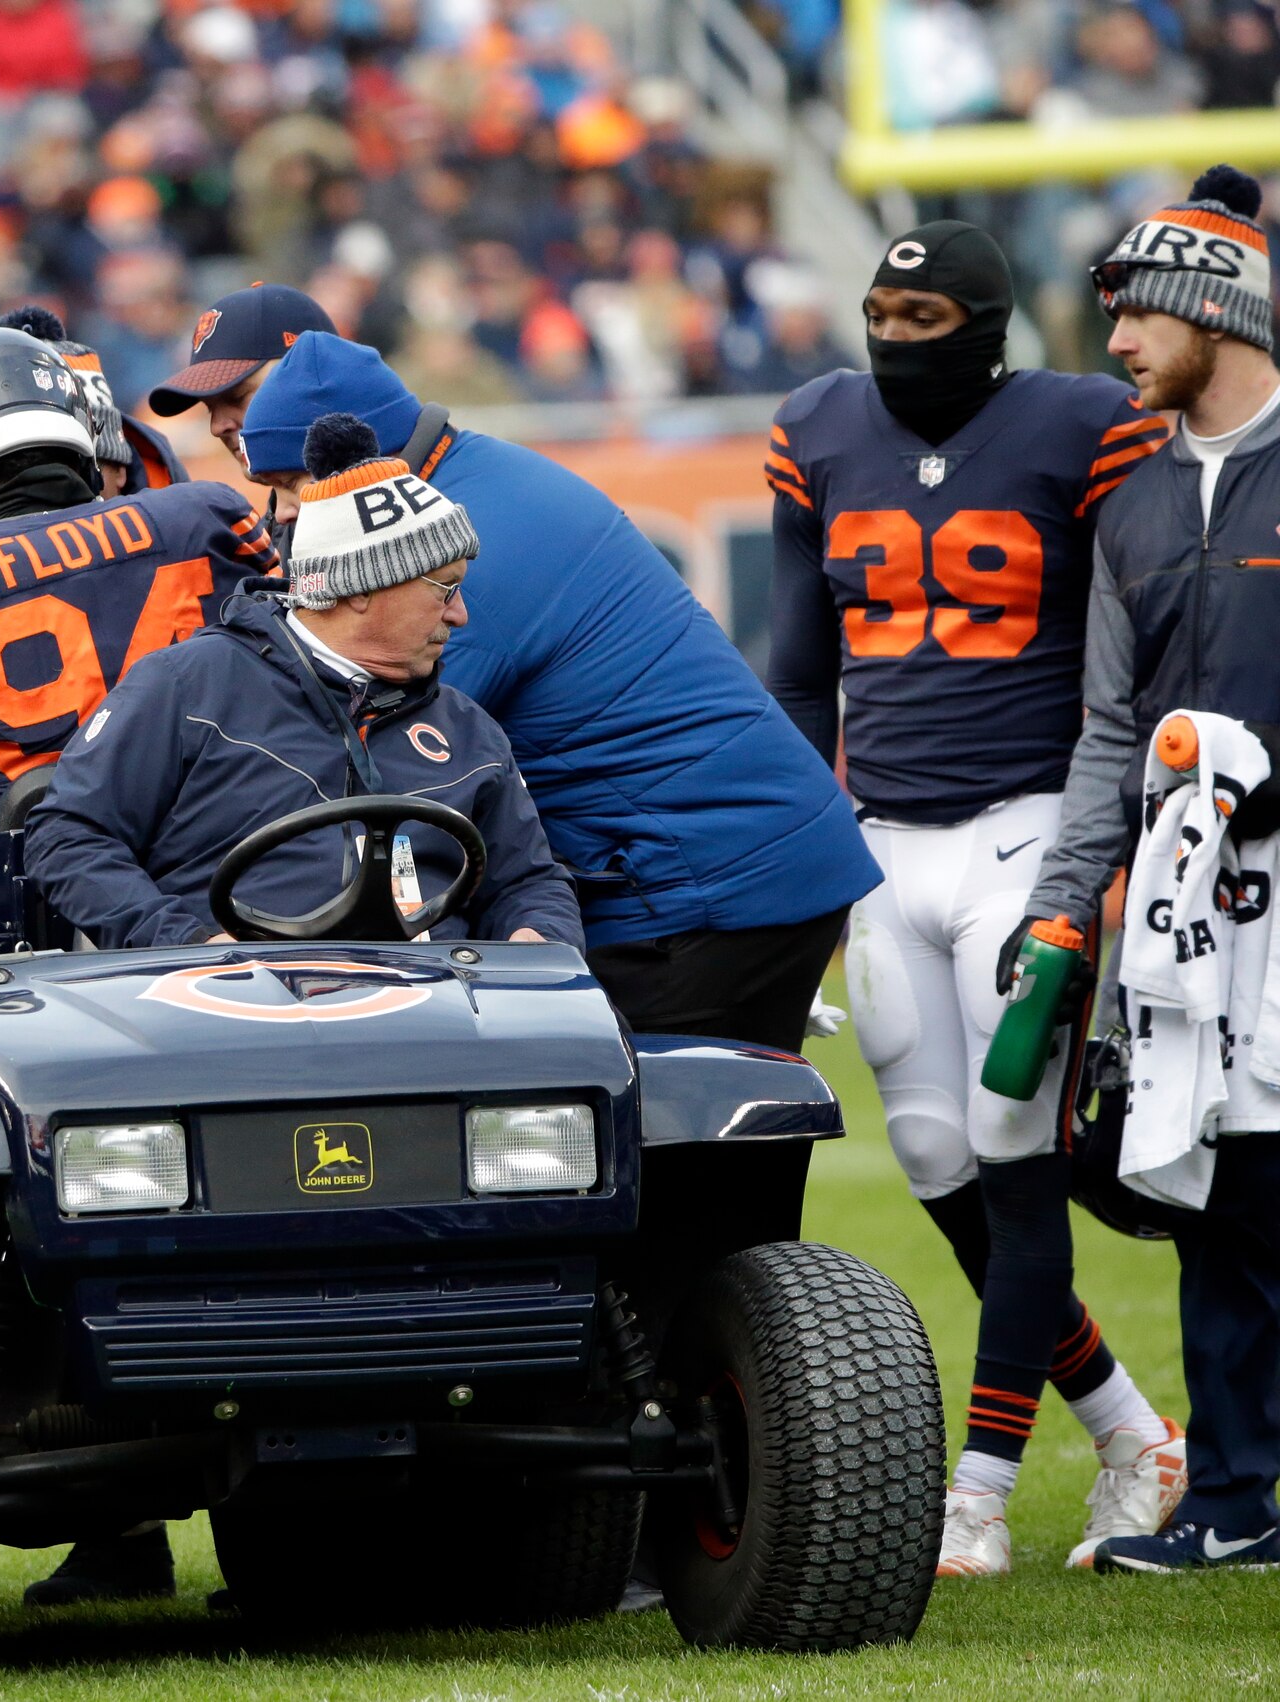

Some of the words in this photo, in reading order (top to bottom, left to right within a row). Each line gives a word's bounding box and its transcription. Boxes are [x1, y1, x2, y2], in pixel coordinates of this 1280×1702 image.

[353, 476, 442, 535] BE
[301, 573, 326, 594] GSH
[827, 509, 1044, 658] 39
[304, 1176, 332, 1187] JOHN
[333, 1175, 366, 1186] DEERE
